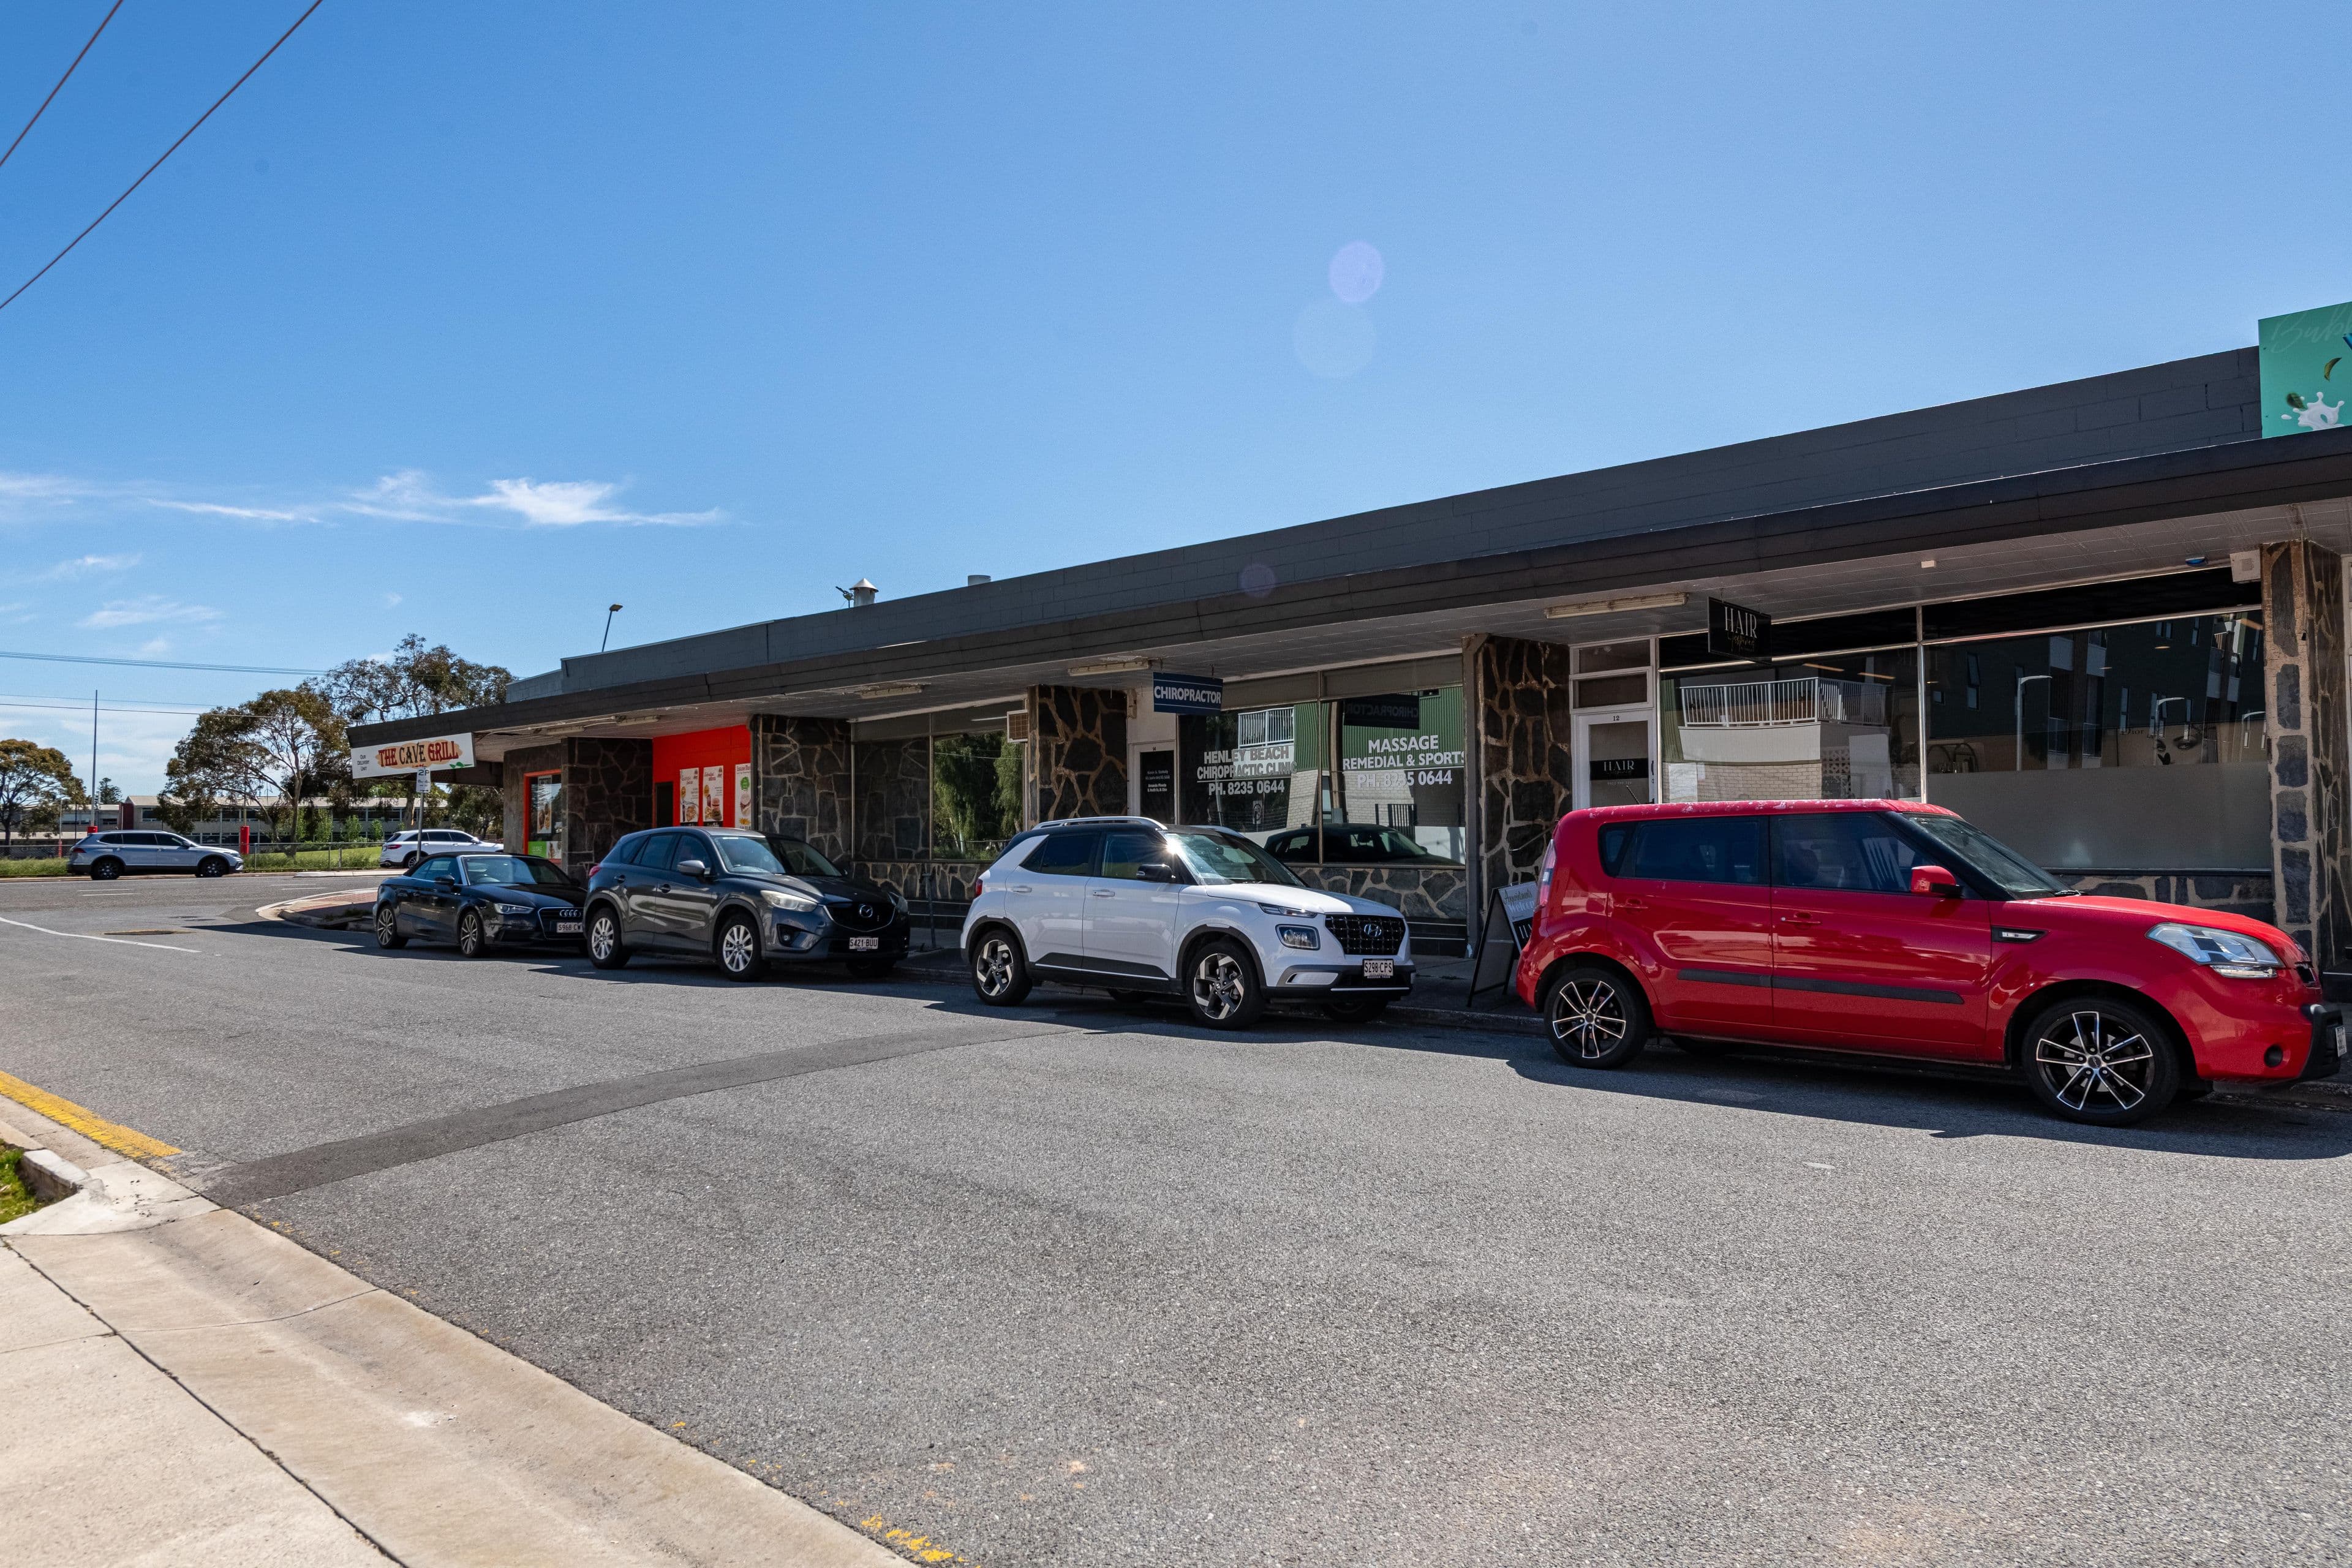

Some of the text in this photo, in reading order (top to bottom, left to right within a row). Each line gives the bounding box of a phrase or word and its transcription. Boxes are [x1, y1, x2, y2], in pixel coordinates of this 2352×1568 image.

[1725, 606, 1757, 638] HAIR
[1154, 685, 1221, 704] CHIROPRACTOR
[1368, 735, 1438, 753] MASSAGE
[379, 741, 459, 767] THE CAVE GRILL
[1204, 746, 1289, 764] HENLEY BEACH
[1343, 755, 1403, 770] REMEDIAL
[1406, 754, 1415, 766] &
[1197, 761, 1298, 779] CHIROPRACTIC CLINIC
[1604, 760, 1634, 771] HAIR
[1208, 780, 1284, 795] PH. 8235 0644
[1357, 770, 1452, 788] PH. 8235 0644
